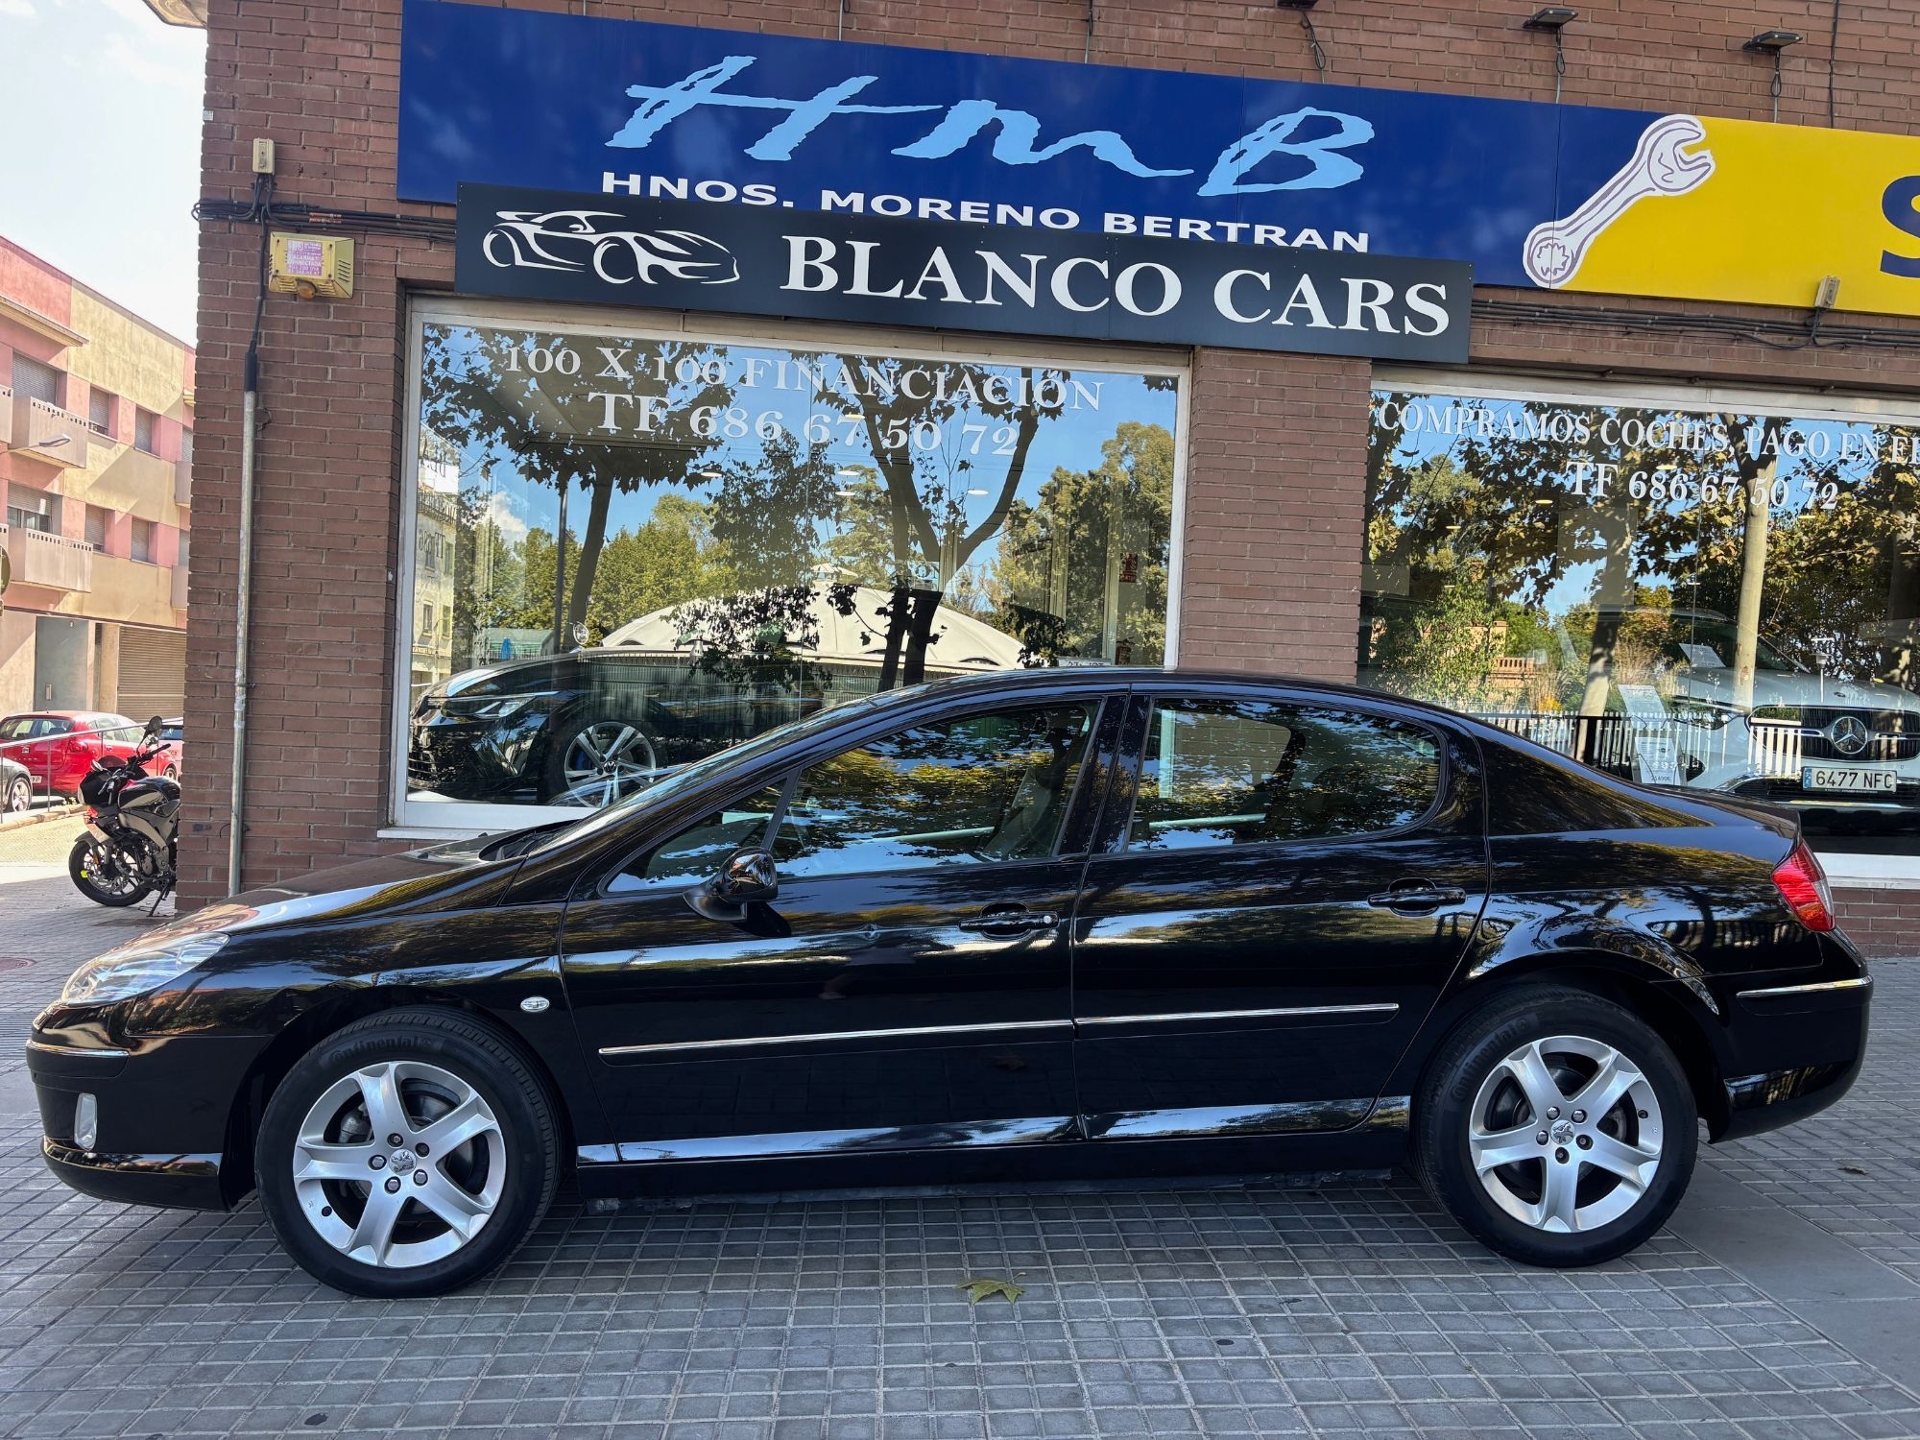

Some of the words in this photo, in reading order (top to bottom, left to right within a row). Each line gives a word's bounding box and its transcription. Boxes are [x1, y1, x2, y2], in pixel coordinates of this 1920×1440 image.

[602, 171, 794, 208] HNOS.
[820, 189, 1080, 230] MORENO
[1103, 212, 1369, 253] BERTRAN
[779, 234, 1182, 317] BLANCO
[1213, 269, 1450, 337] CARS
[505, 347, 581, 375] 100
[595, 347, 634, 379] X
[653, 356, 727, 386] 100
[741, 355, 1105, 411] FINANCIACIÓN
[587, 391, 671, 432] TF
[689, 405, 784, 442] 686
[803, 413, 865, 446] 67
[882, 416, 942, 452] 50
[961, 422, 1019, 456] 72
[1378, 401, 1591, 444] COMPRAMOS
[1599, 417, 1735, 457] COCHES,
[1744, 426, 1830, 458] PAGO
[1838, 432, 1883, 462] EN
[1565, 461, 1618, 498] TF
[1628, 470, 1689, 501] 686
[1700, 475, 1741, 505] 67
[1749, 476, 1790, 509] 50
[1800, 480, 1839, 510] 72
[1815, 770, 1858, 788] 6477
[1863, 772, 1893, 789] NFC
